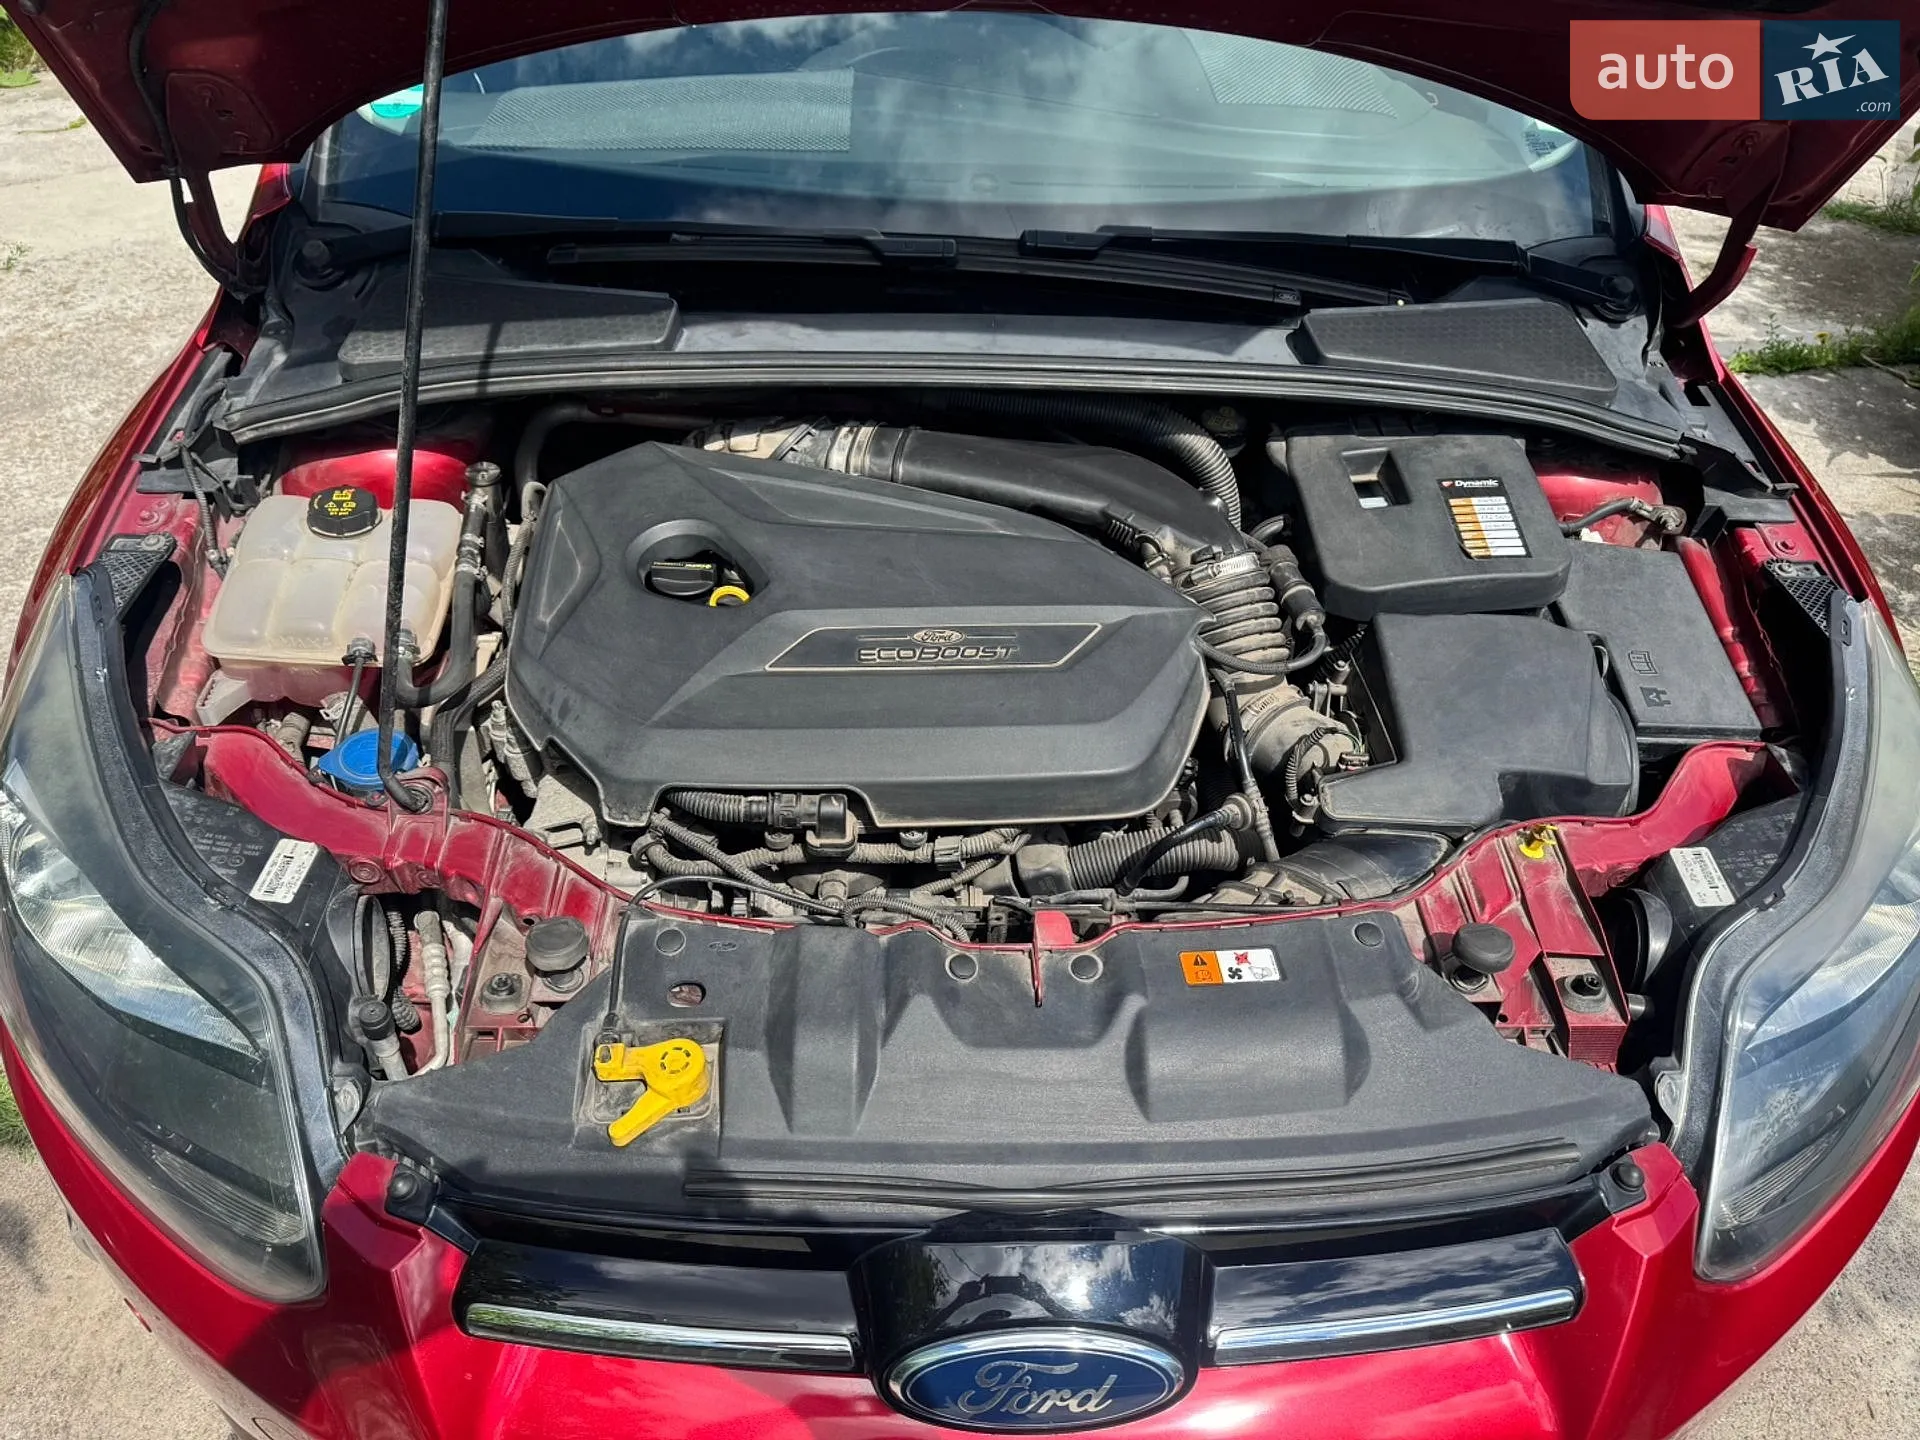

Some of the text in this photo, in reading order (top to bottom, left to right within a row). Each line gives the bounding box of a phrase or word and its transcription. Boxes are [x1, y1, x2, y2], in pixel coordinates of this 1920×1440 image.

[1454, 479, 1500, 488] Dynamic
[920, 629, 955, 643] Ford
[957, 1359, 1118, 1416] Ford
